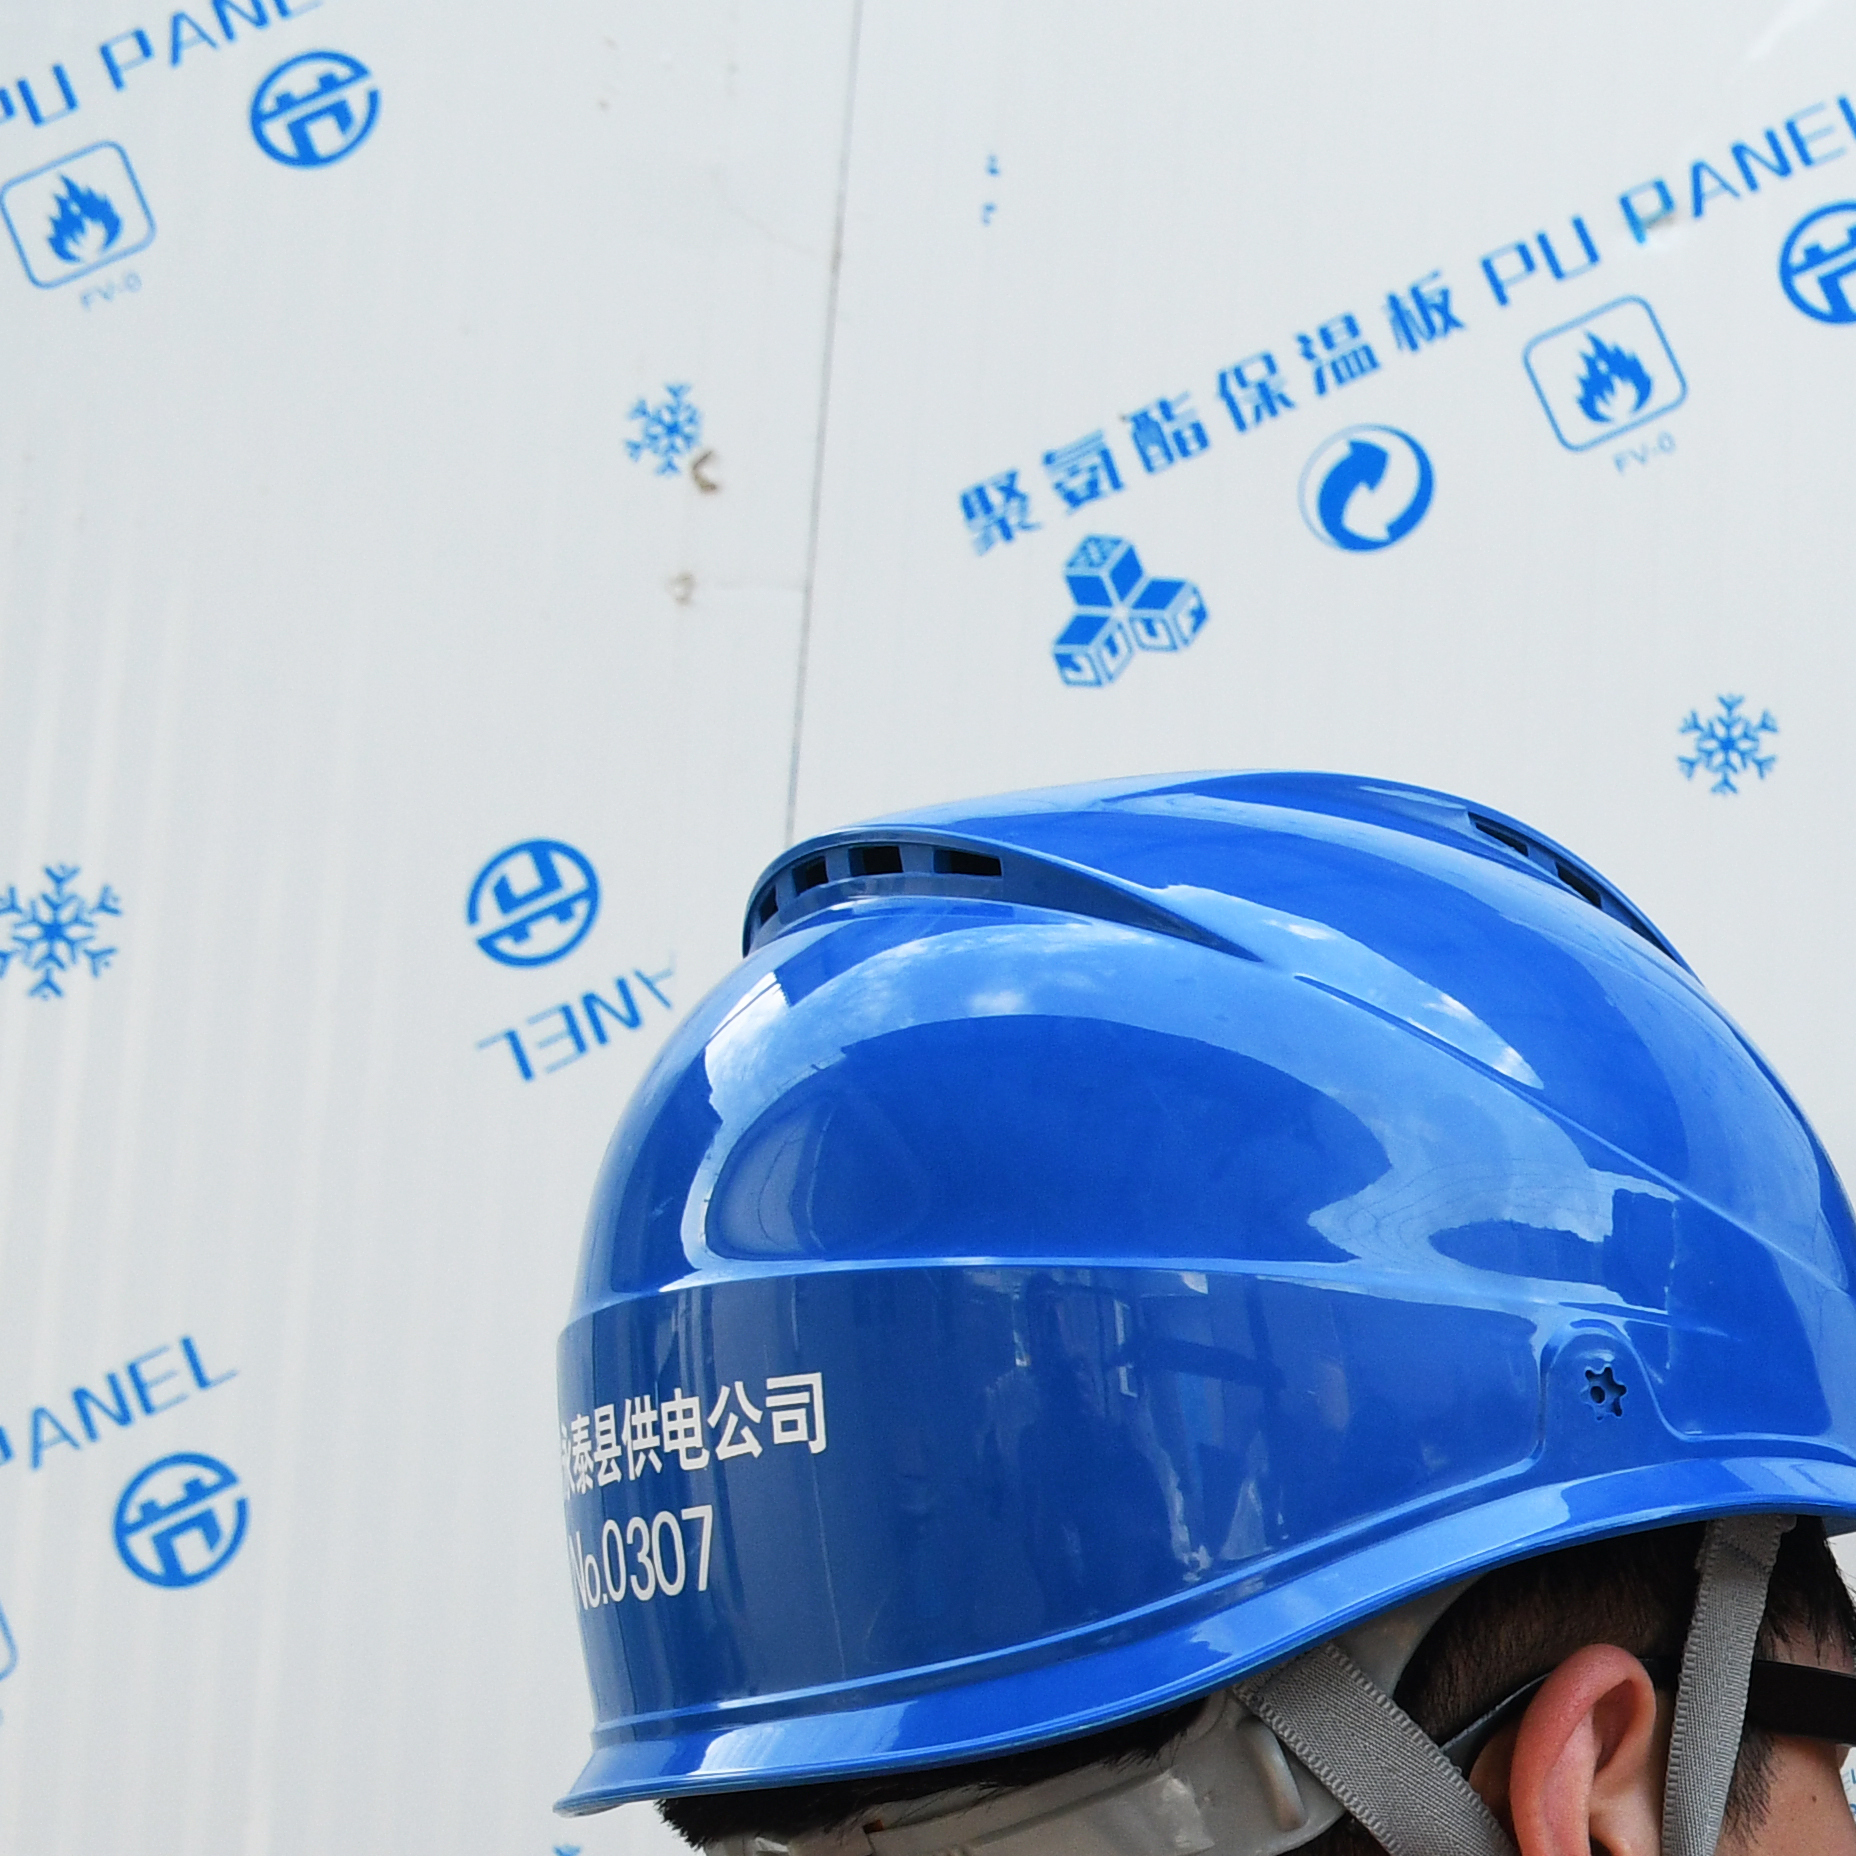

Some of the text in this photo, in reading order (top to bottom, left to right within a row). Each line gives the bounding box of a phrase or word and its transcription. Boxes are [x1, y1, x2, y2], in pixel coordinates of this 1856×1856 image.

[960, 268, 1467, 556] 聚氨酯保温板
[1480, 214, 1601, 307] PU
